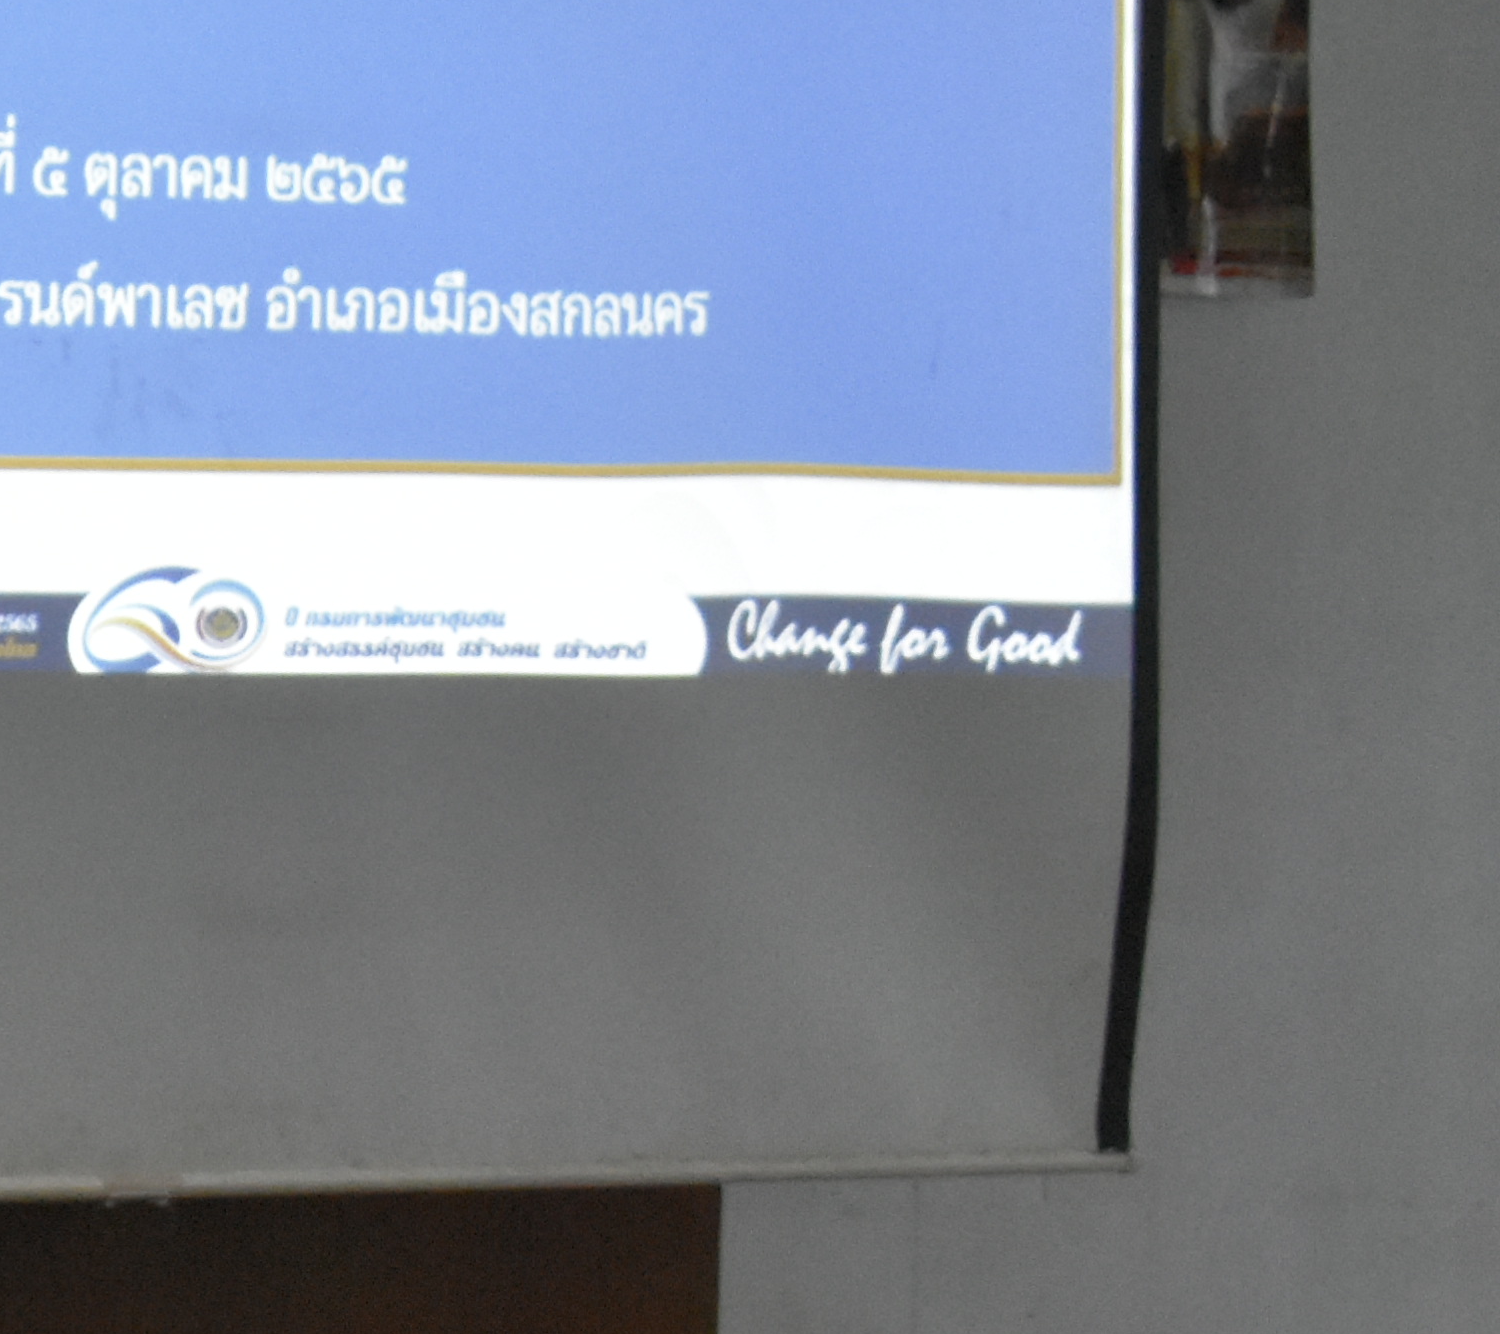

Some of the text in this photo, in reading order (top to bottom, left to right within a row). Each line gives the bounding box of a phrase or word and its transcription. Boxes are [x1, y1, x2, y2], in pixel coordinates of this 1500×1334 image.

[32, 146, 69, 198] ๕
[84, 151, 248, 221] ตุลาคม
[264, 152, 409, 205] ๒๕๖๕
[266, 267, 710, 338] อำเภอเมืองสกลนคร
[304, 607, 506, 633] กรมการพัฒนาชุมชน
[726, 598, 1083, 675] Change for Good
